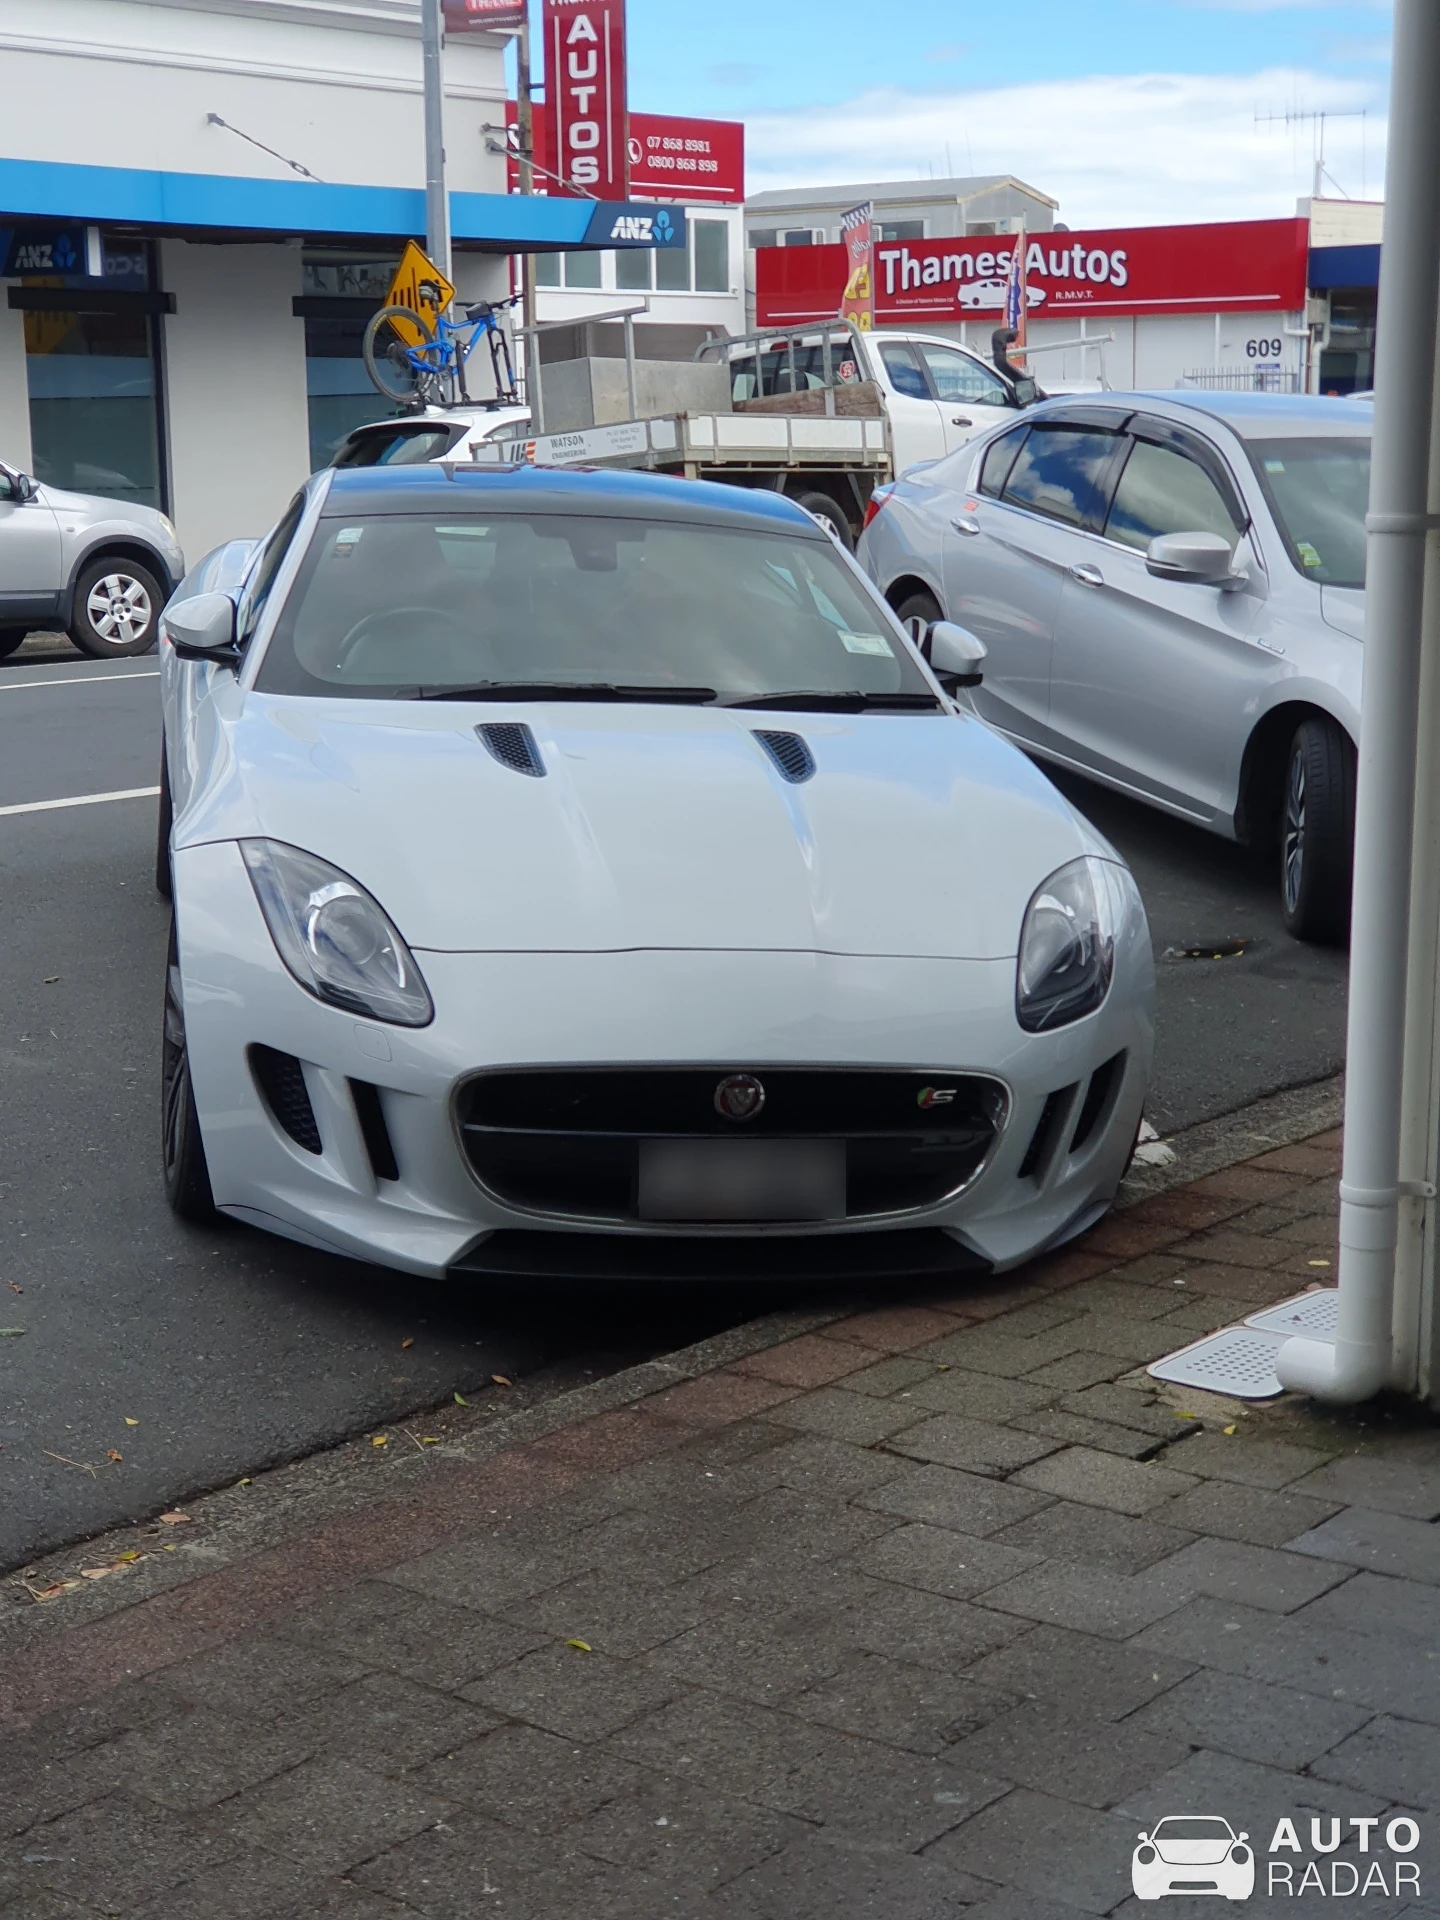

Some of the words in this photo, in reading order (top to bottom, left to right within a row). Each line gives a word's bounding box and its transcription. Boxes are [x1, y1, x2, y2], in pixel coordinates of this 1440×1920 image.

[566, 14, 600, 184] AUTOS
[646, 135, 661, 150] 07
[662, 137, 683, 151] 868
[647, 155, 675, 169] 0800
[676, 157, 697, 171] 868
[610, 215, 653, 240] ANZ
[15, 244, 53, 268] ANZ
[878, 247, 1012, 295] Thames
[1025, 242, 1129, 287] Autos
[1246, 338, 1282, 358] 609
[550, 435, 584, 448] WATSON
[551, 448, 587, 460] ENGINEERING
